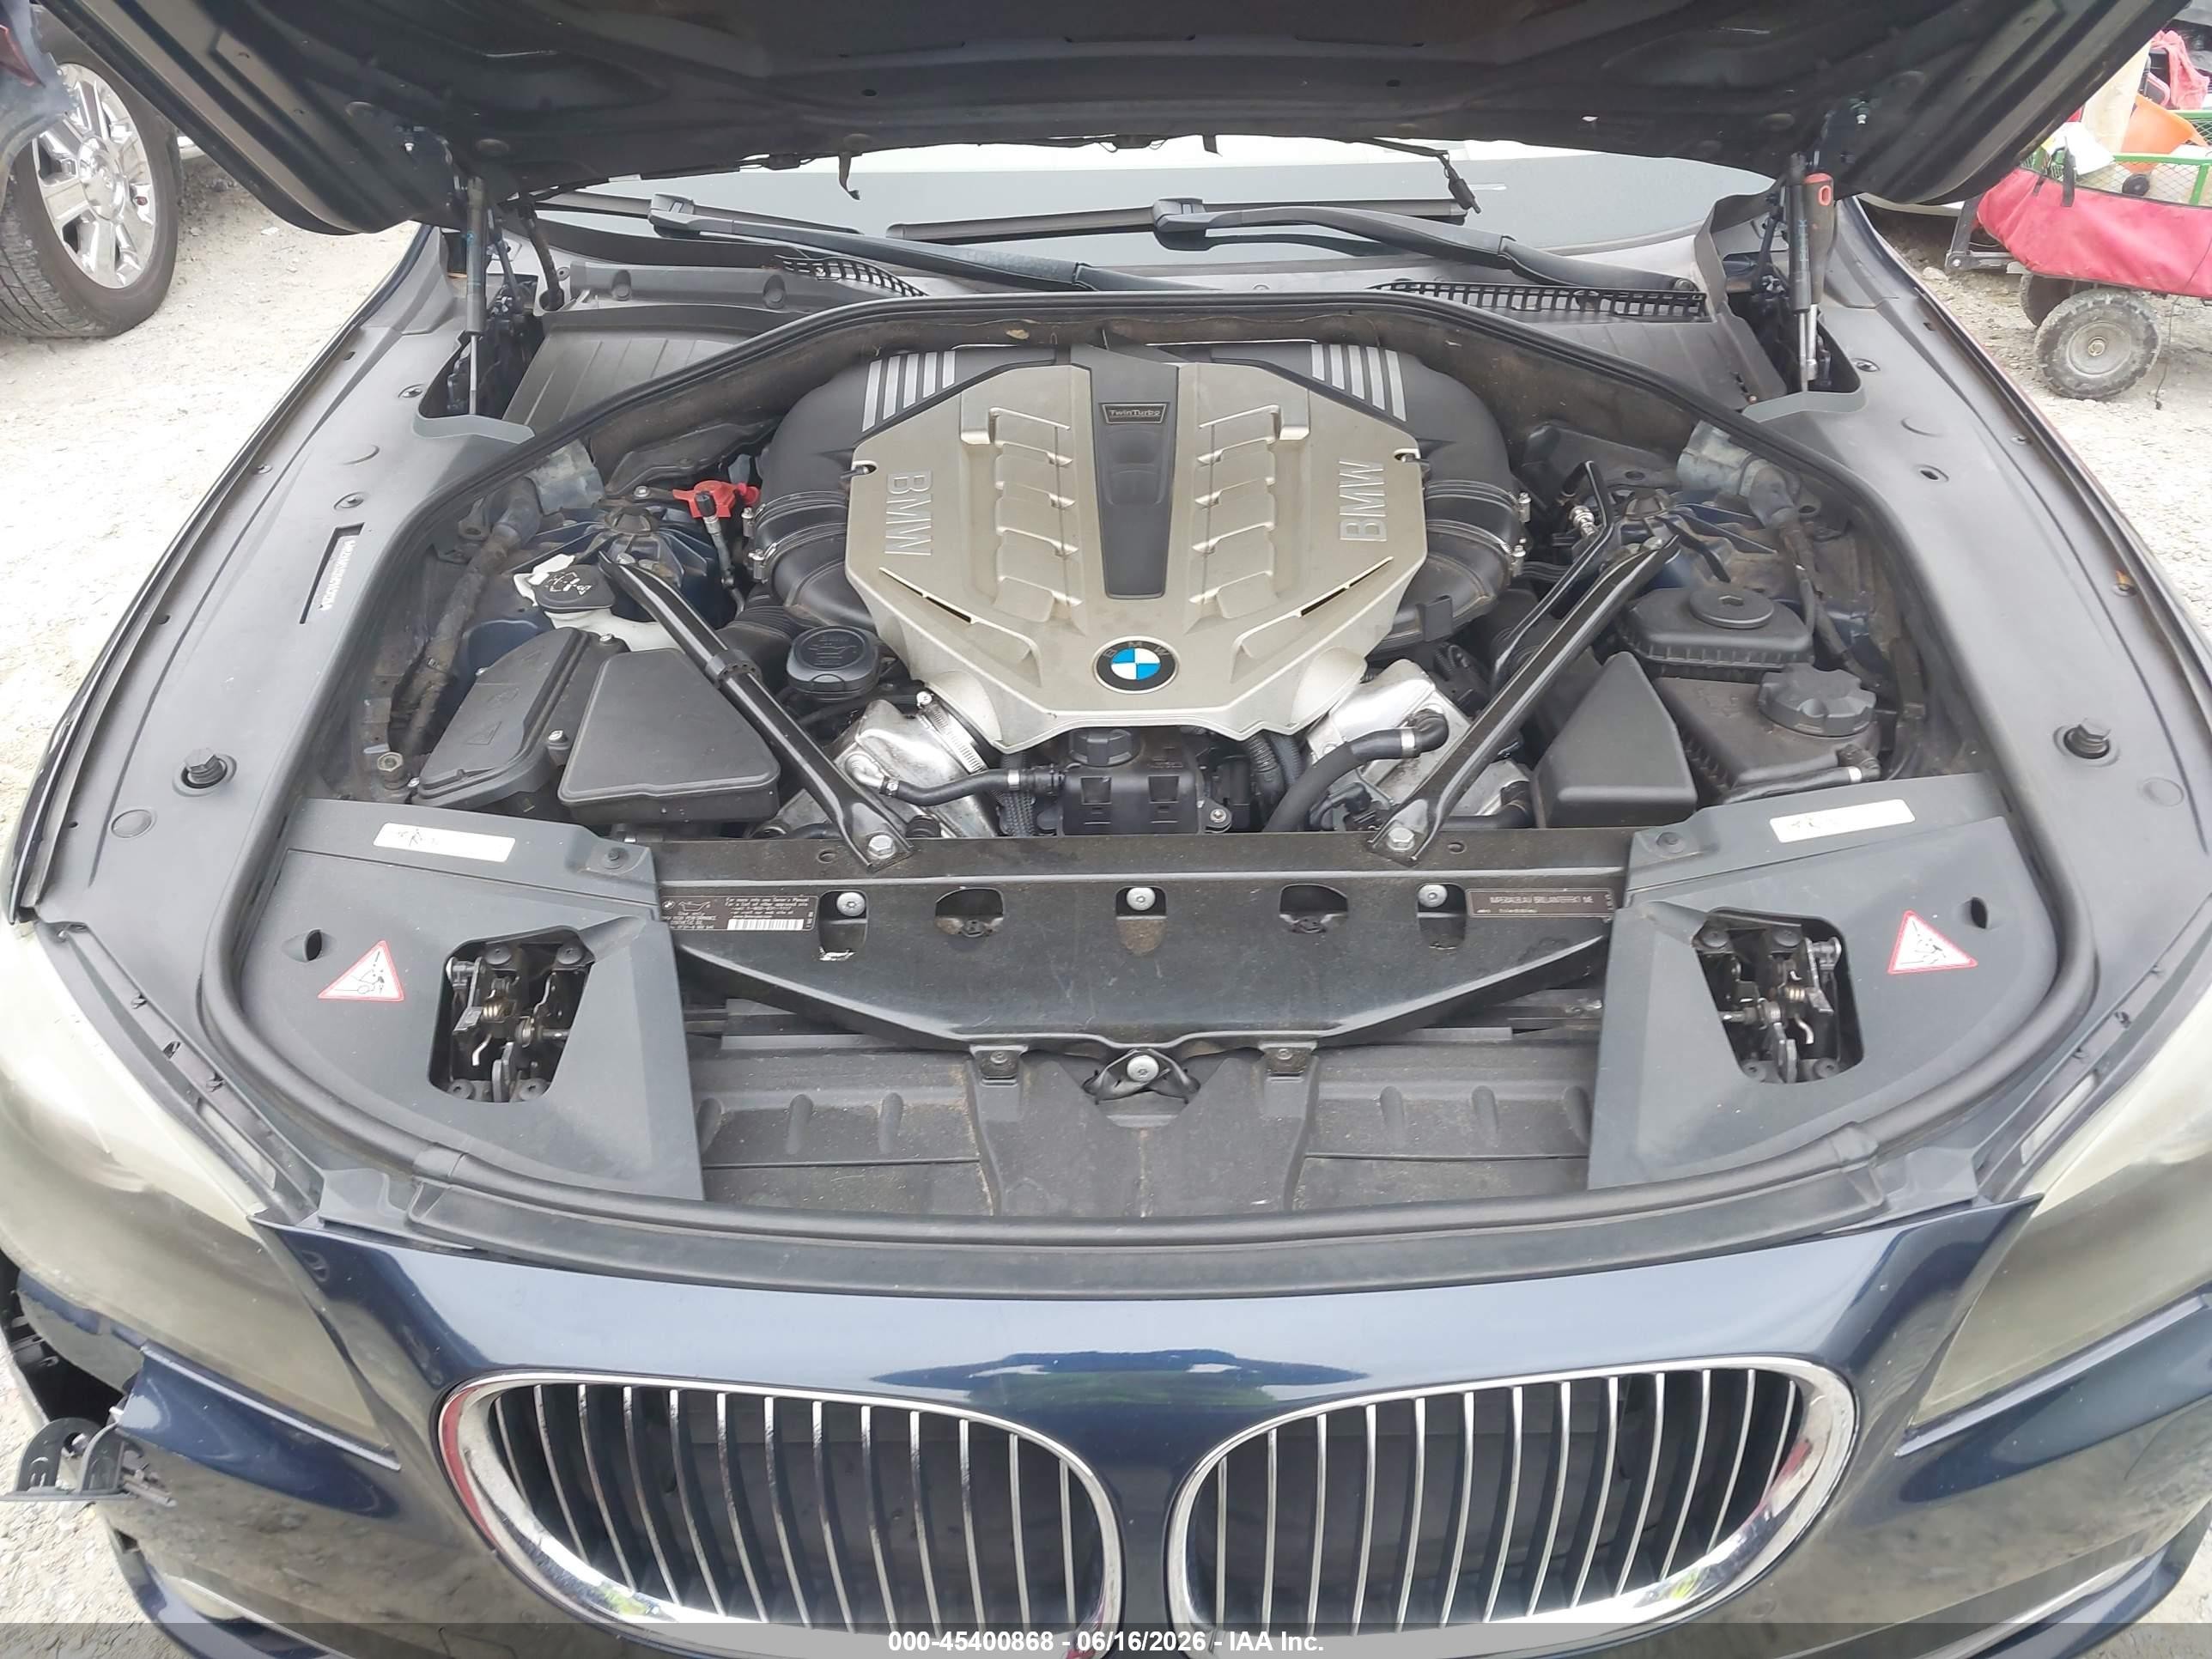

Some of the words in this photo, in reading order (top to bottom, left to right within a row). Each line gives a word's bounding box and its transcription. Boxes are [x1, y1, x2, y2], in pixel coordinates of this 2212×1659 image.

[884, 469, 933, 556] BMW
[1339, 457, 1388, 543] BMW
[1103, 641, 1170, 659] BMW
